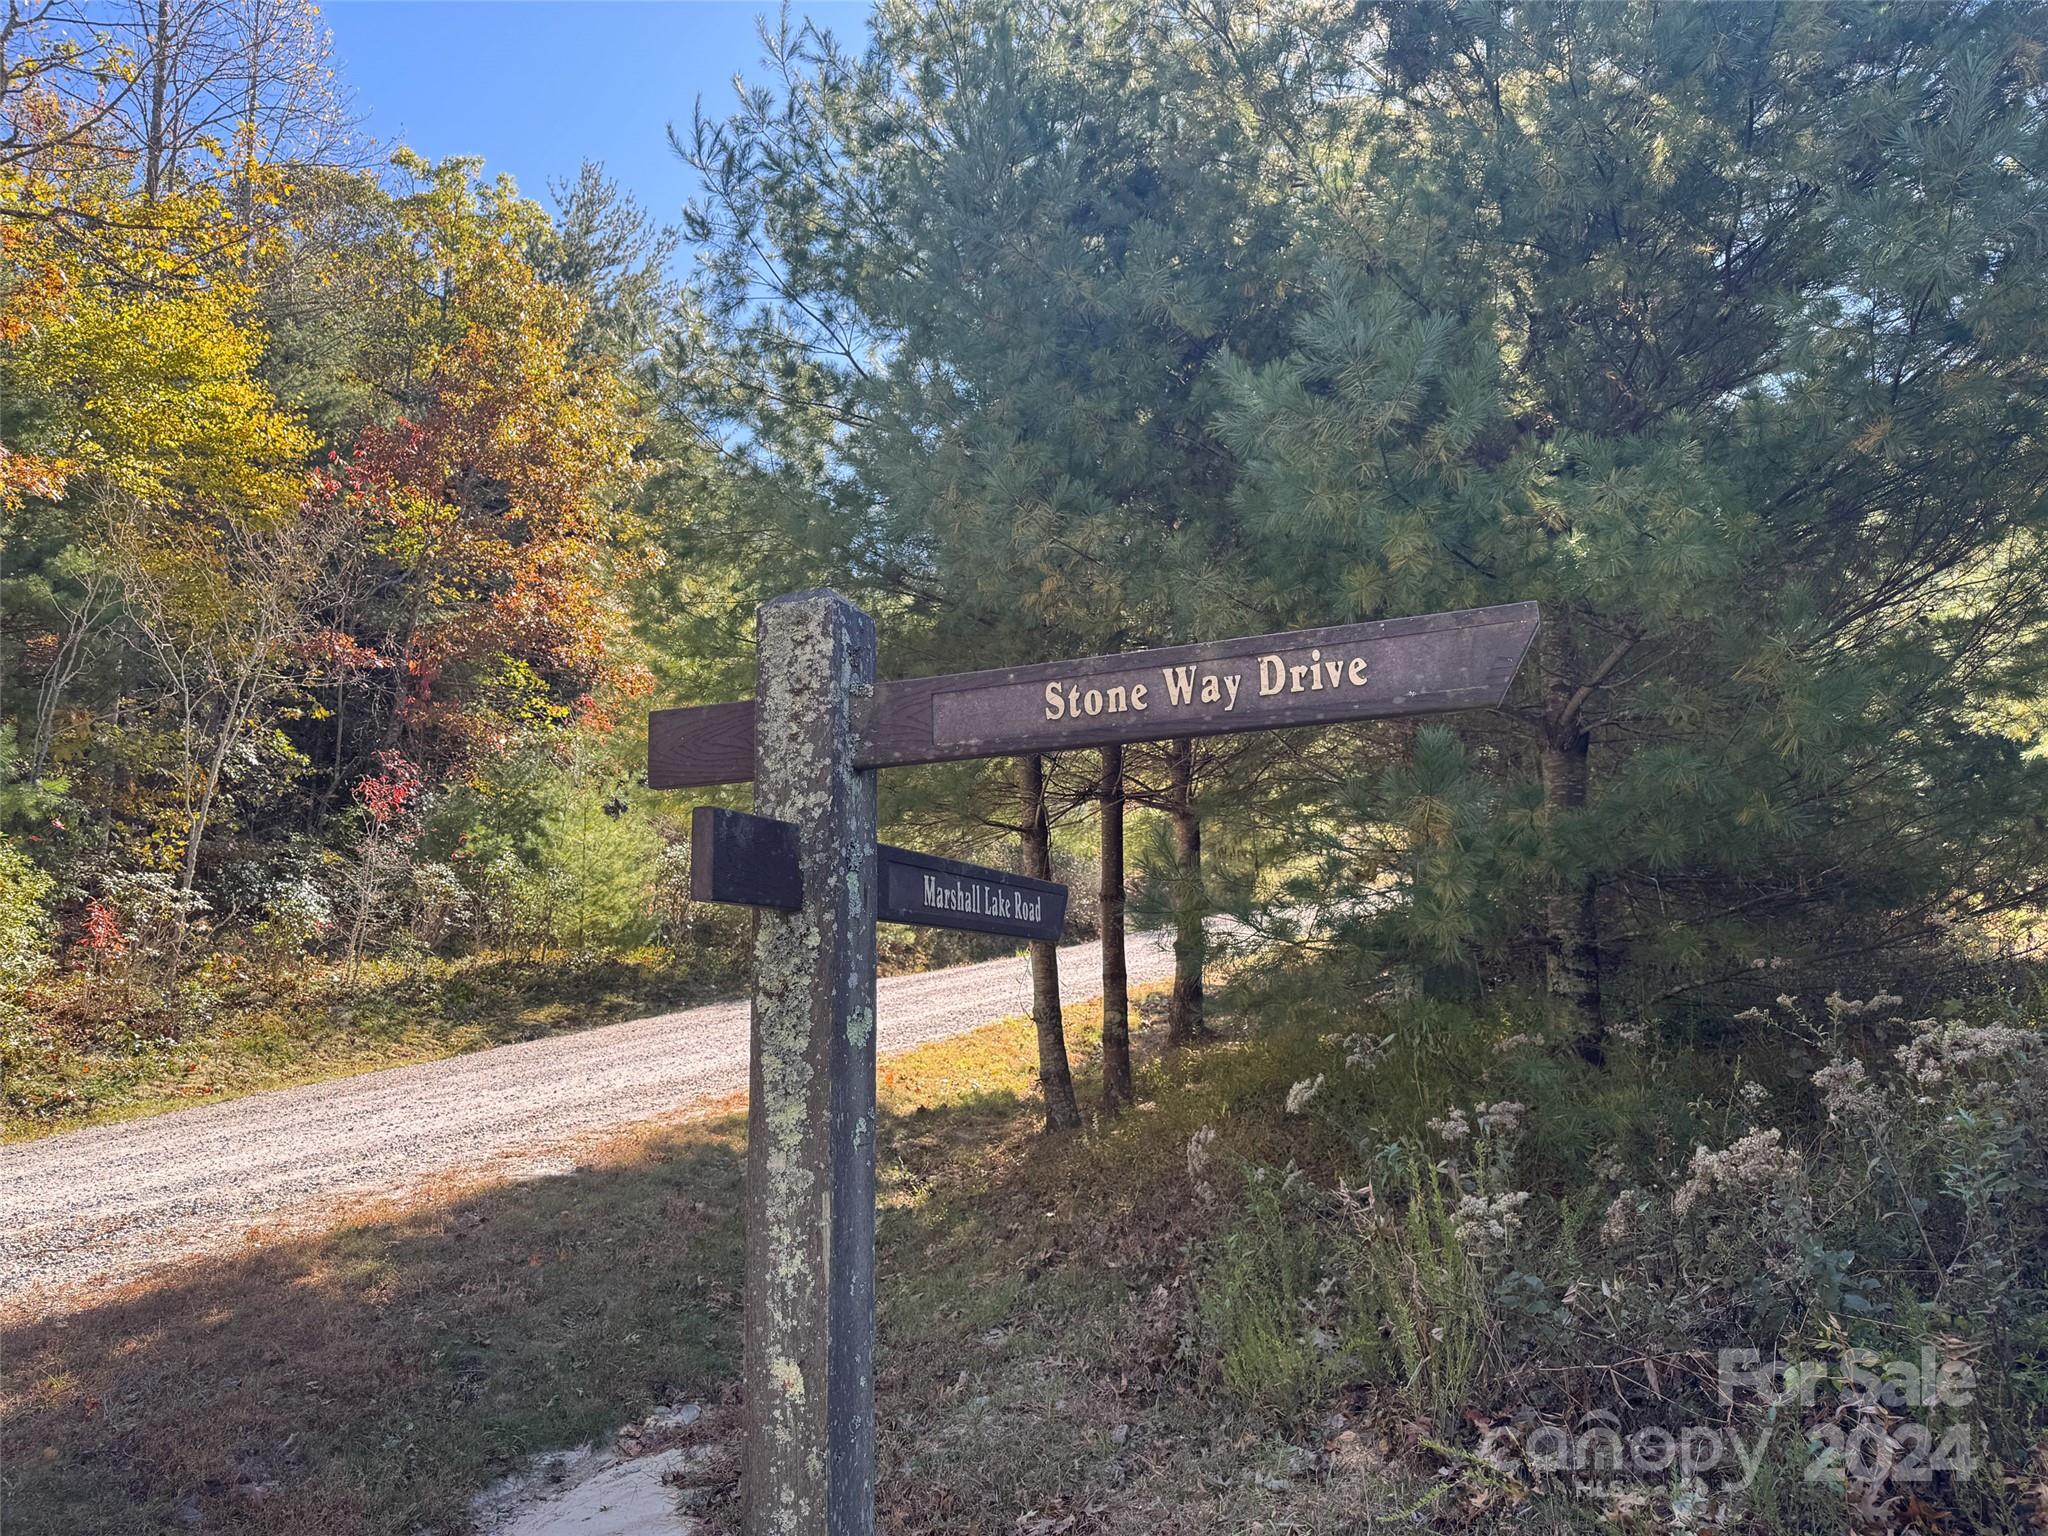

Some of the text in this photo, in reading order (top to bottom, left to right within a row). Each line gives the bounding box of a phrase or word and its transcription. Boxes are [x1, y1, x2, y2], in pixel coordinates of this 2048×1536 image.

[1045, 649, 1368, 720] Stone Way Drive
[923, 874, 1041, 922] Marshall Lake Road
